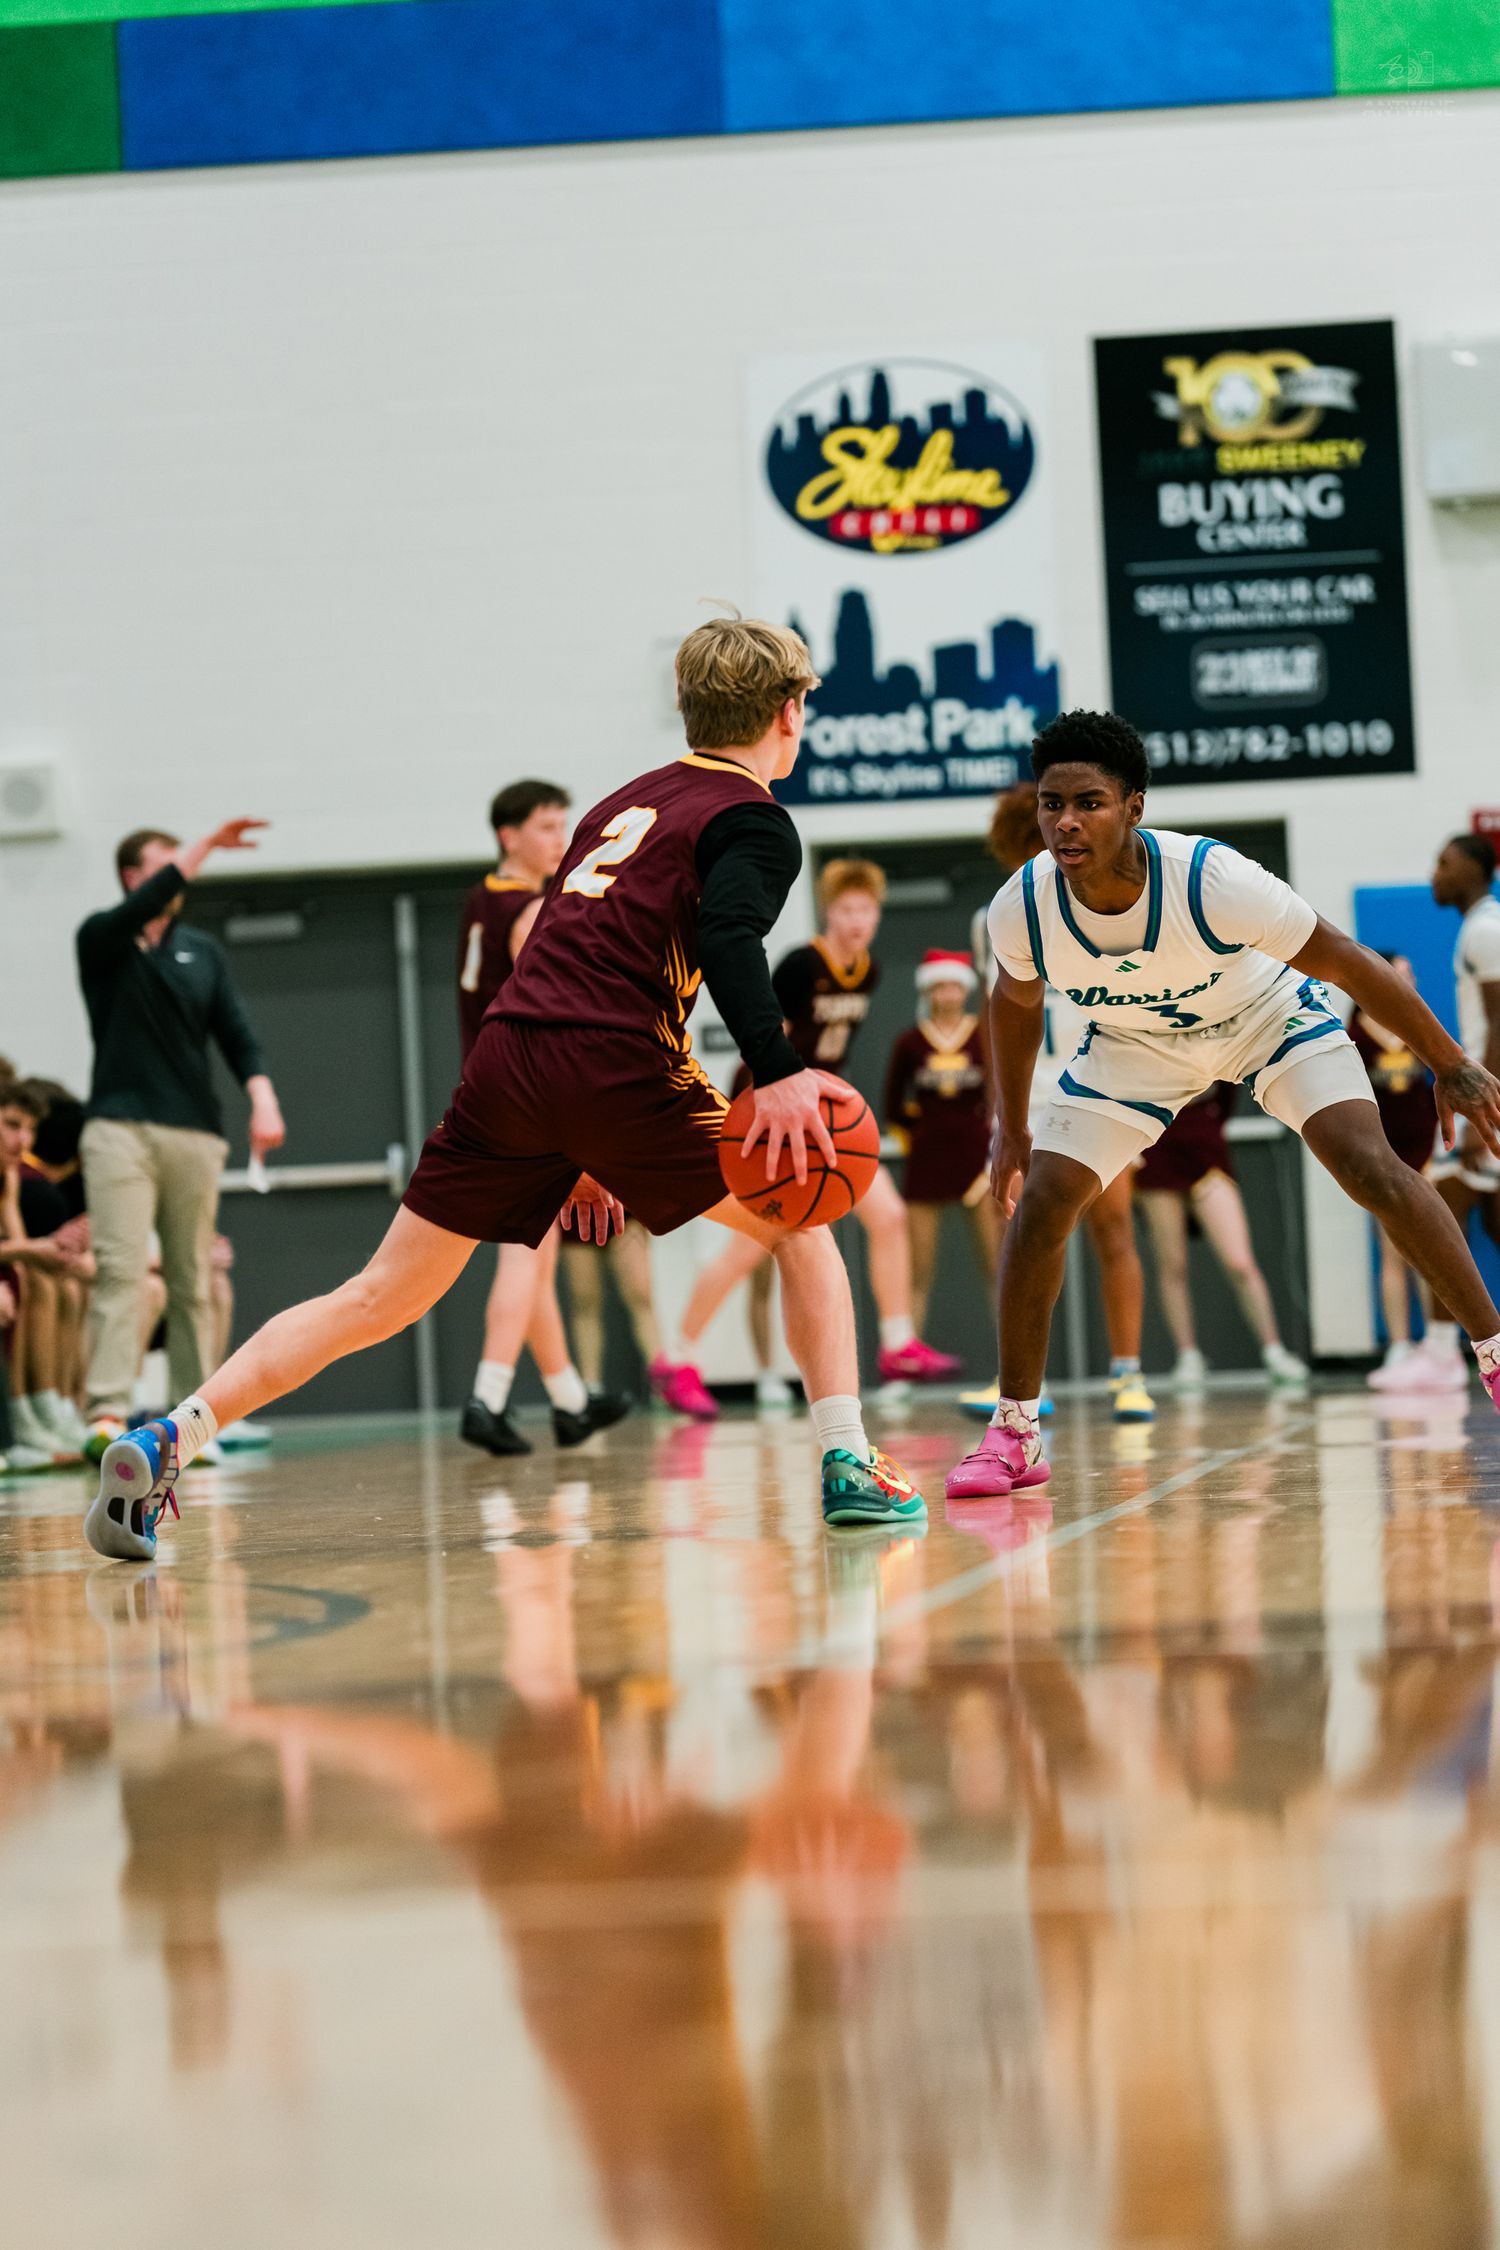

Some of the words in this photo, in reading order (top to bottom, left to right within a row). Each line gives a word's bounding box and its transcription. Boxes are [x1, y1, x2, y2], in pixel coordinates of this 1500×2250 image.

[797, 424, 1009, 519] Skyline
[1217, 440, 1365, 473] SWEENEY
[1159, 476, 1344, 527] BUYING
[1197, 519, 1306, 552] CENTER
[1193, 581, 1232, 608] US
[1234, 577, 1311, 605] YOUR
[1314, 573, 1376, 603] CAR
[932, 698, 1037, 751] Park
[1146, 721, 1393, 768] 513)782-1010
[852, 761, 943, 798] Skyline
[561, 806, 657, 898] 2
